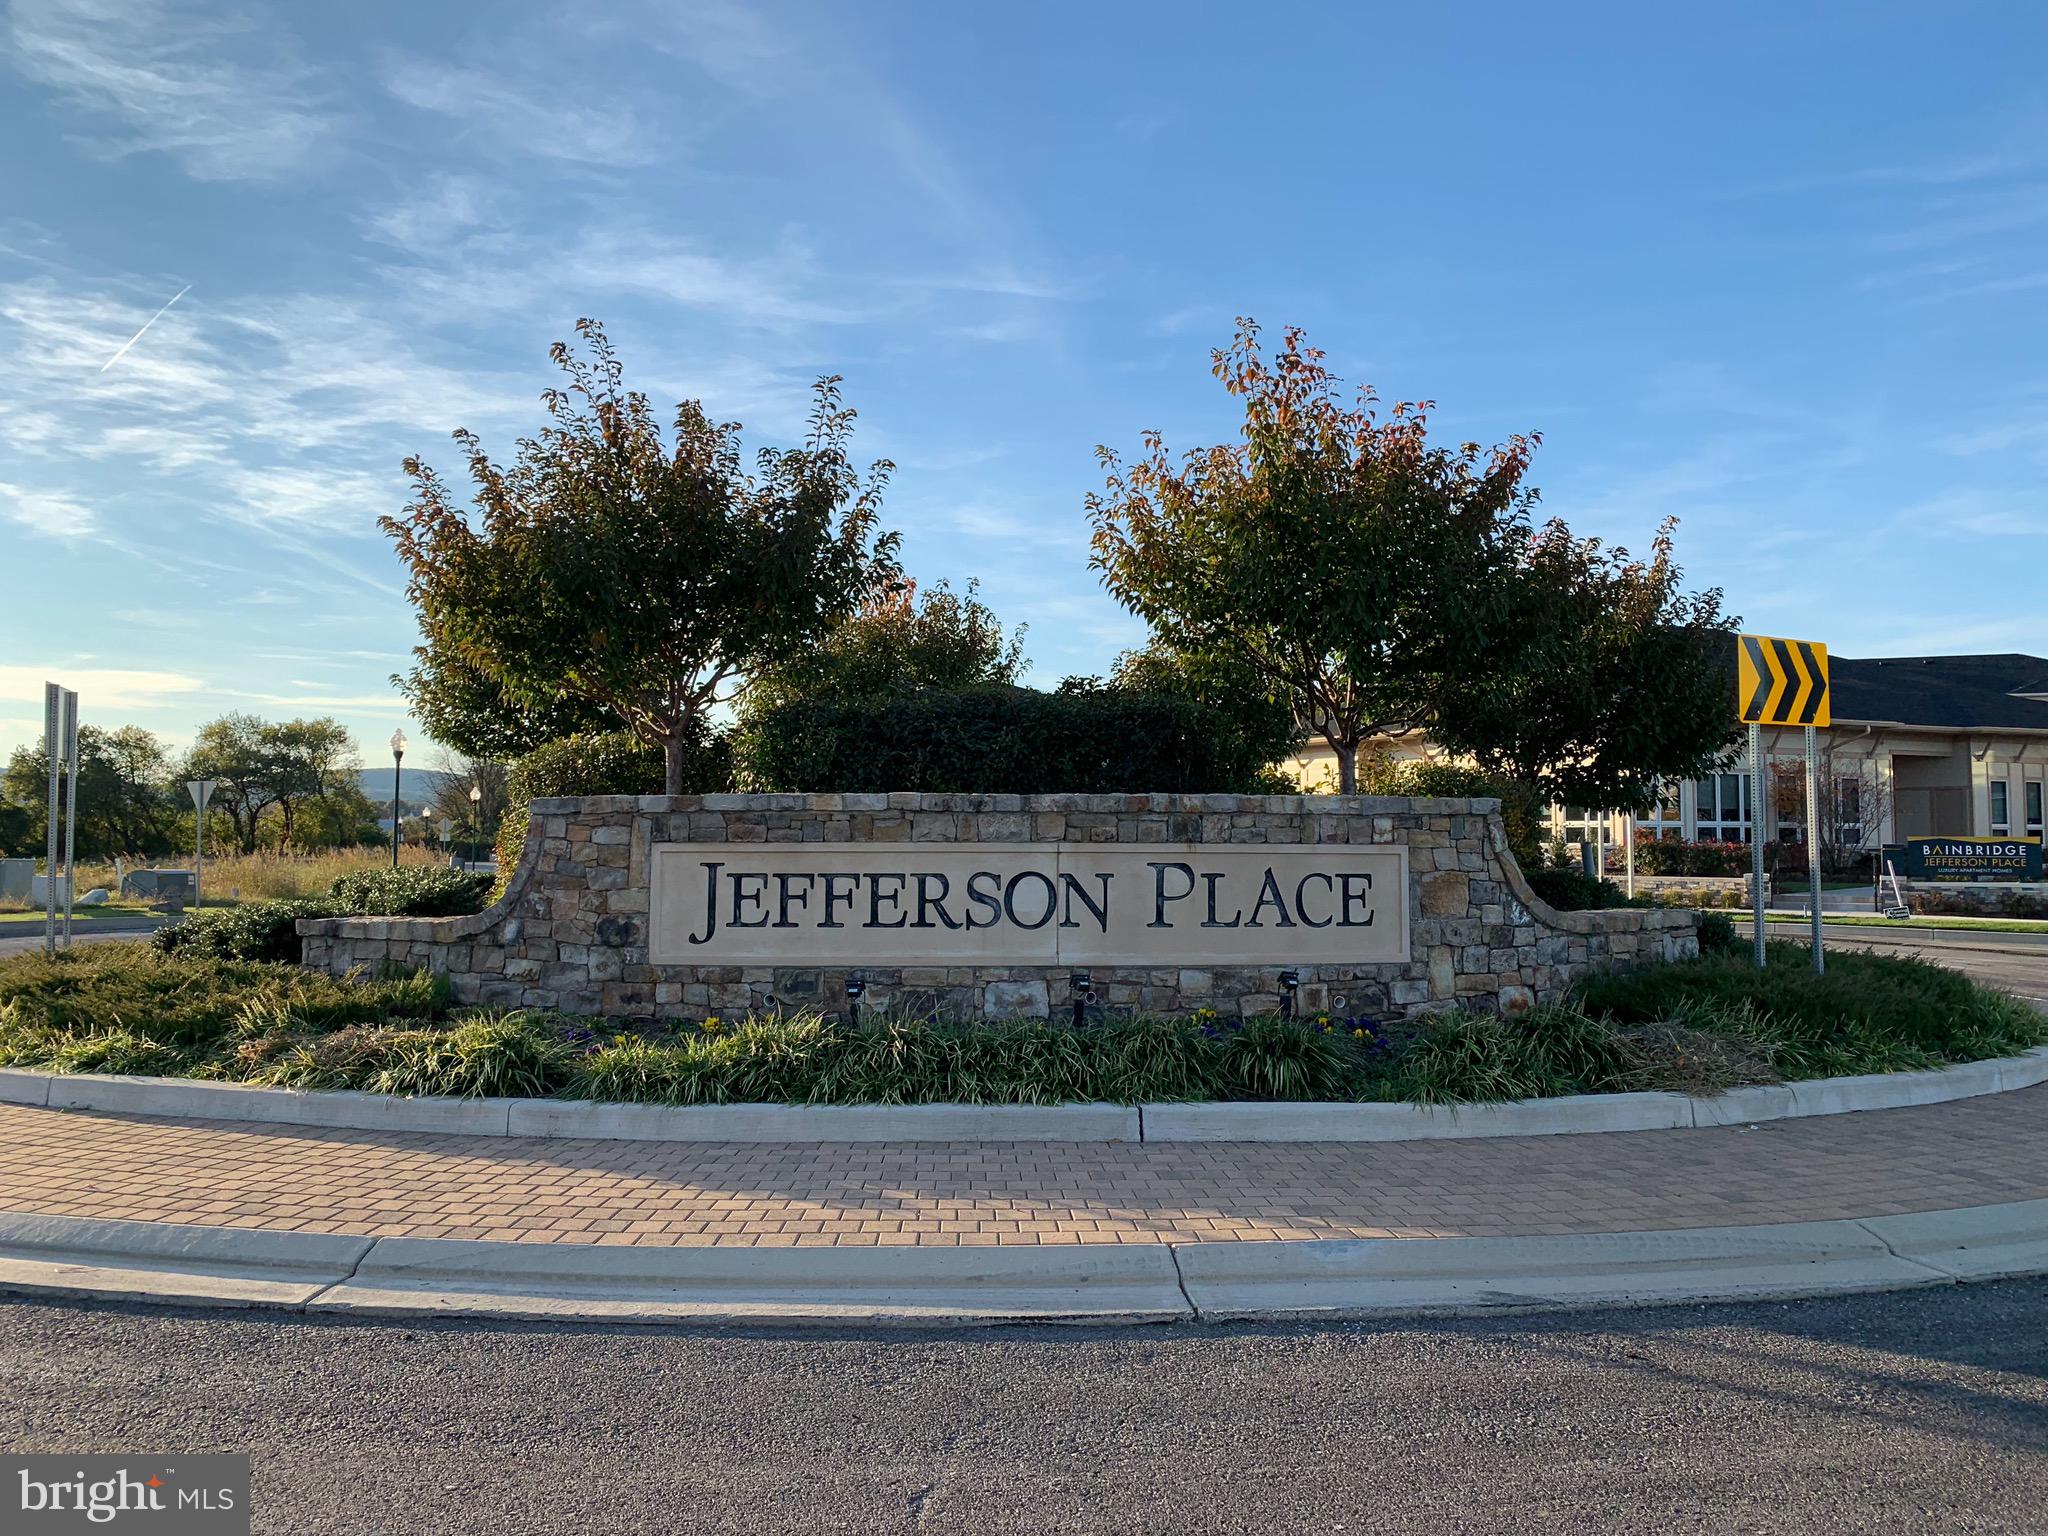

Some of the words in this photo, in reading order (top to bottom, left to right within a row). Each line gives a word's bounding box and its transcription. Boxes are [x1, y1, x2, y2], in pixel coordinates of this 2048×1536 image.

[1923, 845, 2027, 856] BAINBRIDGE
[1924, 858, 1987, 867] JEFFERSON
[1992, 858, 2027, 867] PLACE
[689, 862, 1114, 944] JEFFERSON
[1146, 862, 1375, 928] PLACE
